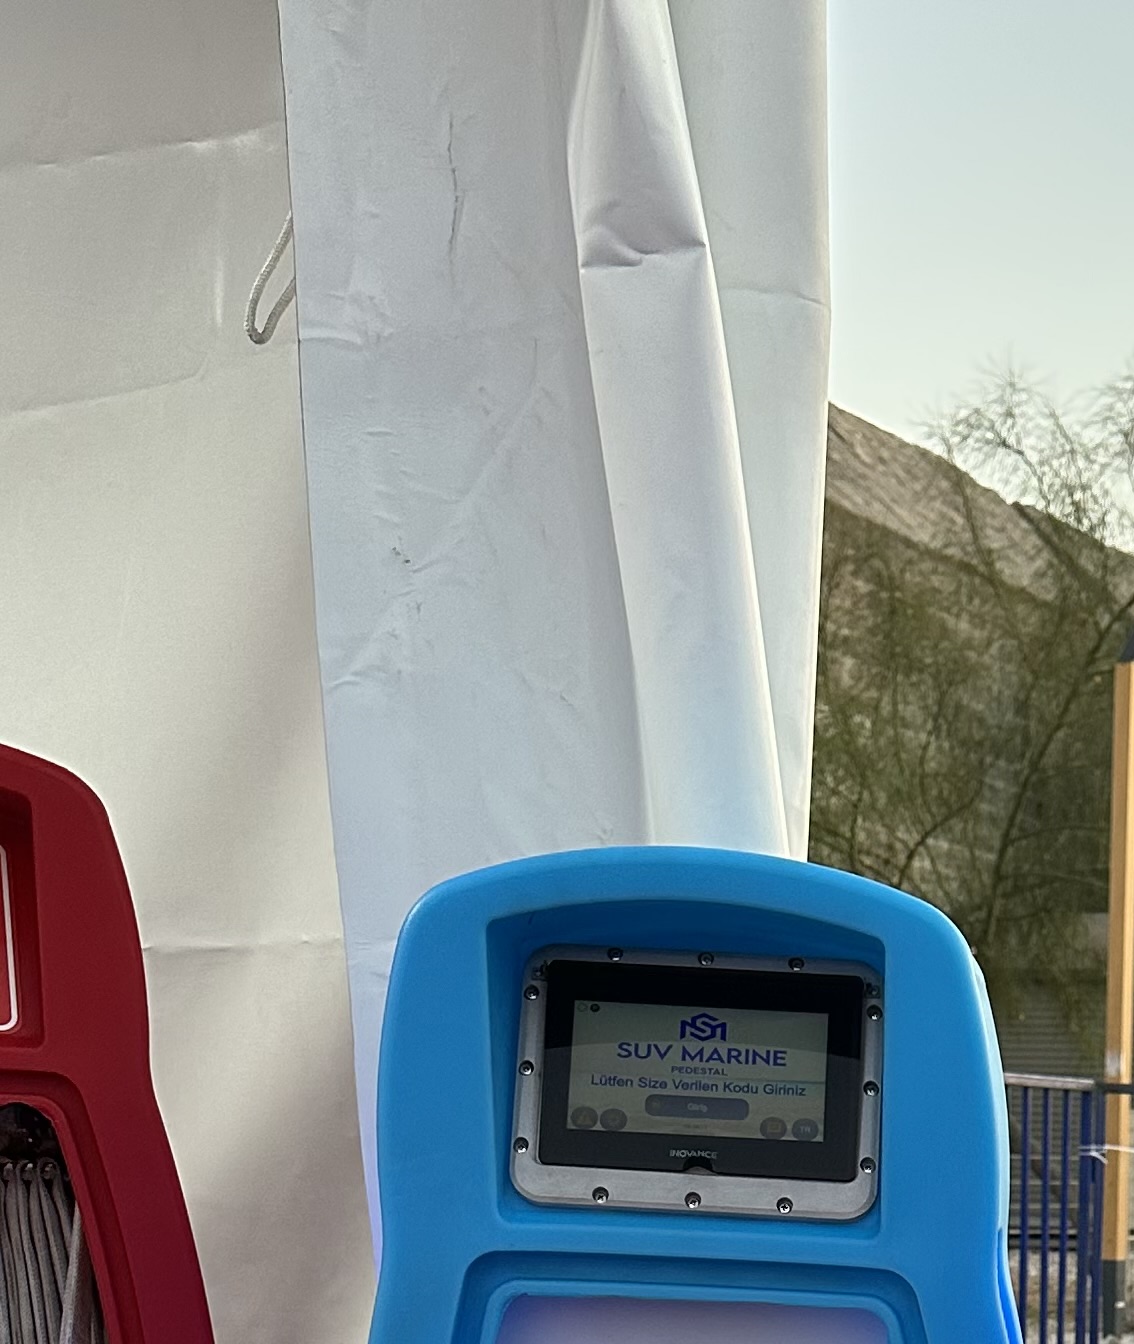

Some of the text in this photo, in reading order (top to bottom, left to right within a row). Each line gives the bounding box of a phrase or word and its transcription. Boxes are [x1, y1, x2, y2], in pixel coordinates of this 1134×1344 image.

[617, 1042, 788, 1067] SUV MARINE
[671, 1065, 728, 1076] PEDESTAL
[591, 1074, 807, 1097] Lütfen Size Verilen Kodu Giriniz
[670, 1149, 718, 1159] INOVANCE
